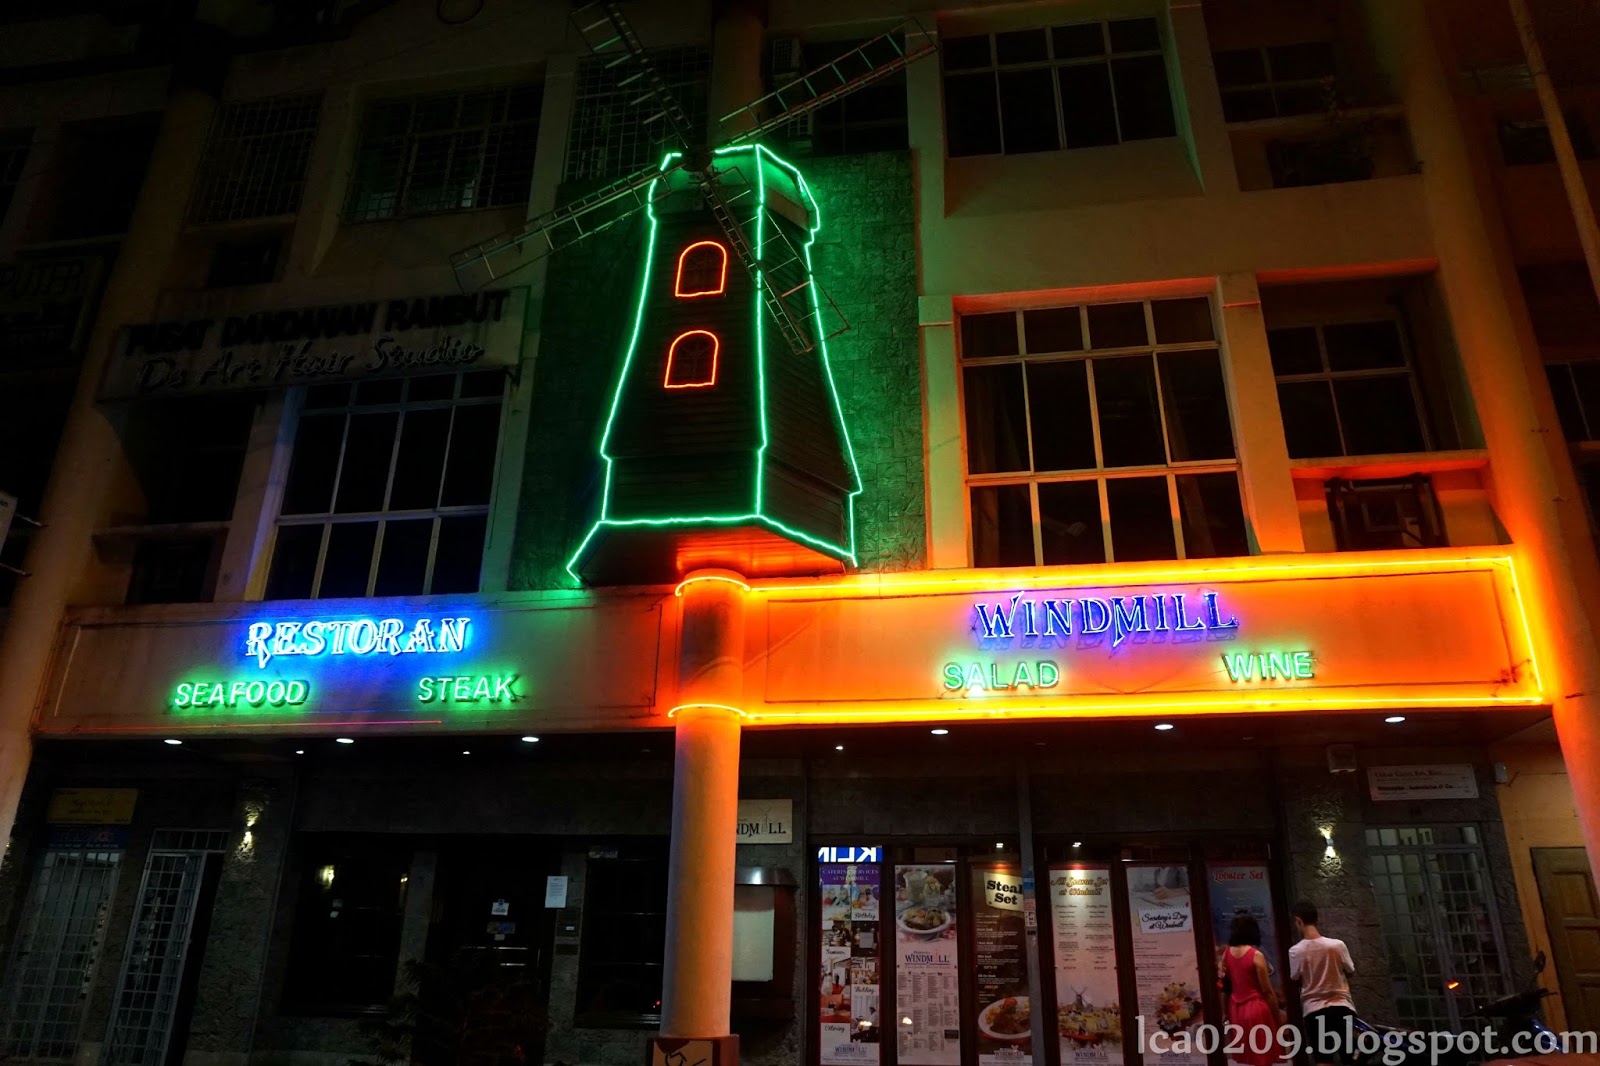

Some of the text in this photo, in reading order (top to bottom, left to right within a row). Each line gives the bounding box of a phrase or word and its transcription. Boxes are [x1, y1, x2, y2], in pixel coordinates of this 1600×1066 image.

[387, 290, 510, 330] RAMBUT
[272, 338, 356, 379] Hair
[365, 336, 484, 372] Studio
[974, 591, 1238, 646] WINDMILL
[246, 617, 471, 668] RESTORAN
[944, 661, 1060, 690] SALAD
[1222, 651, 1314, 681] WINE
[174, 681, 308, 707] SEAFOOD
[418, 675, 518, 703] STEAK
[994, 892, 1018, 905] Set
[1172, 912, 1188, 921] Day
